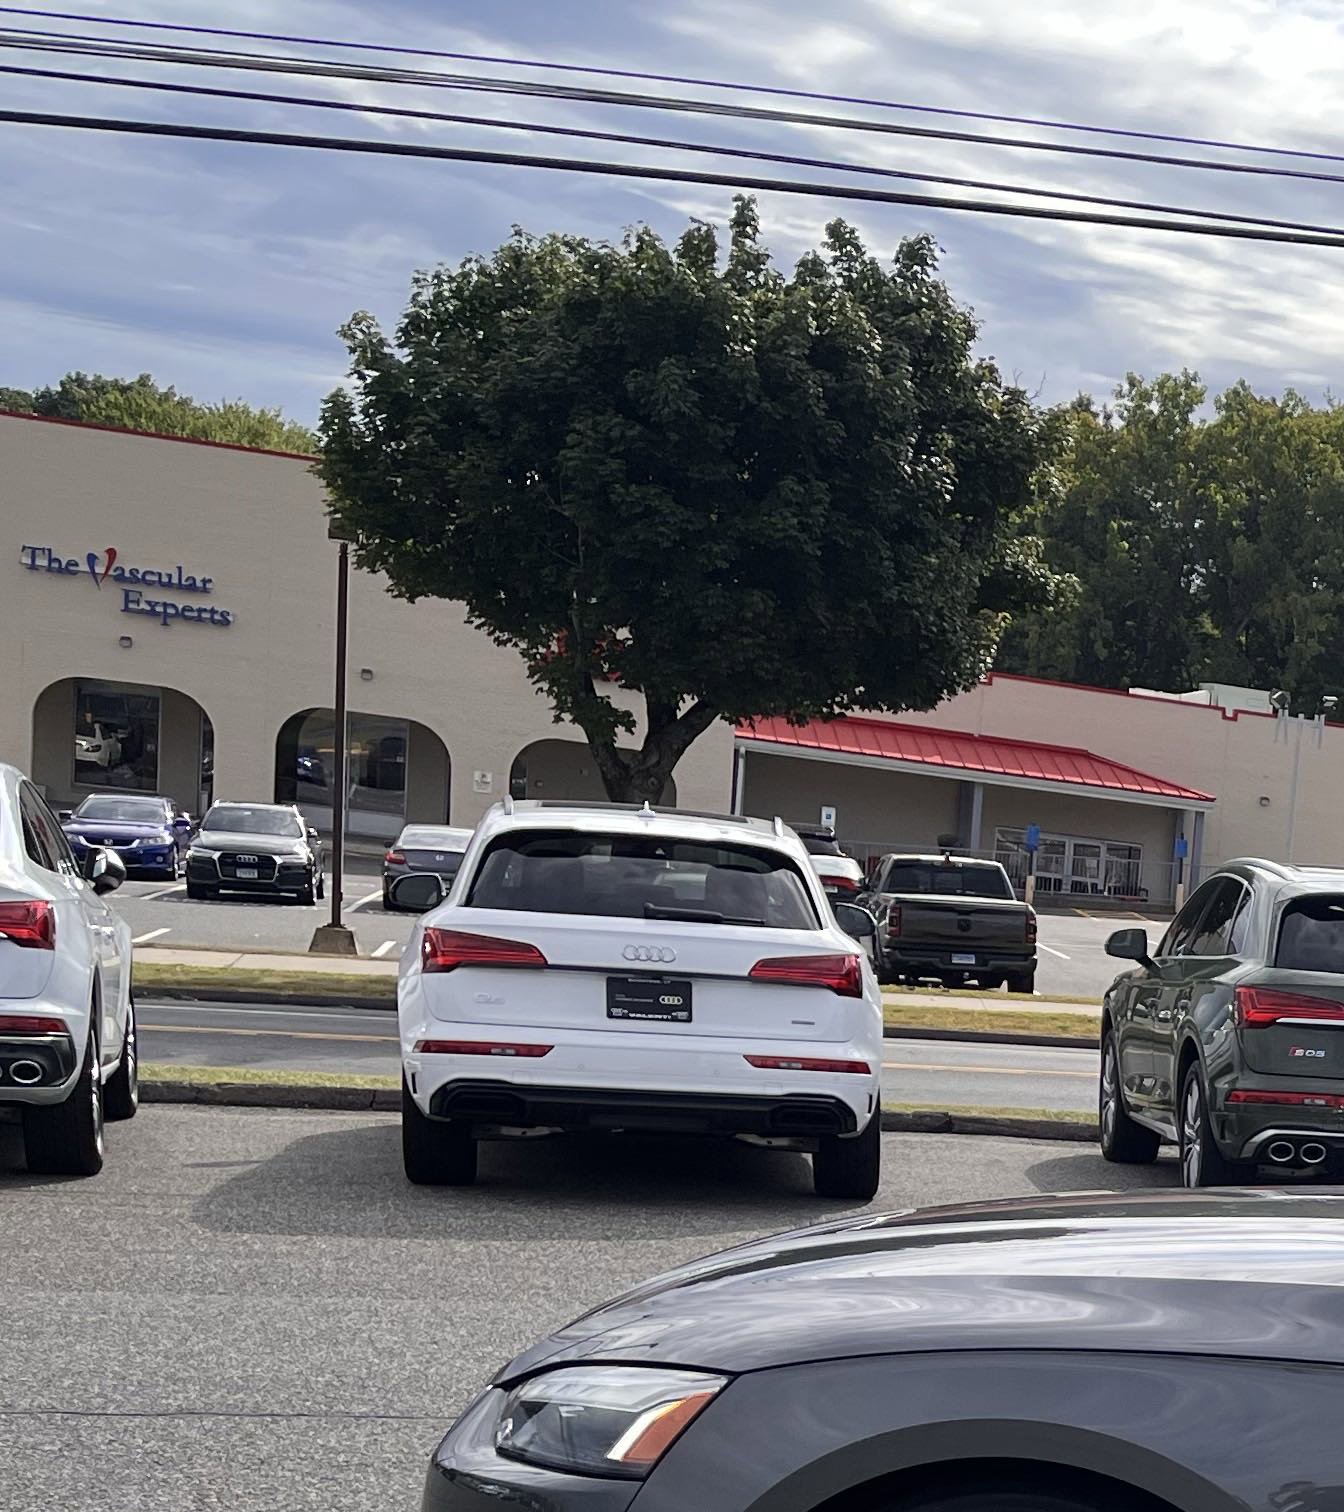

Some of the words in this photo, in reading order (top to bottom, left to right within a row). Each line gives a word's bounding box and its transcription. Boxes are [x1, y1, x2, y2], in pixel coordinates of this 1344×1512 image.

[20, 544, 80, 576] The
[86, 547, 214, 593] Vascular
[120, 588, 235, 627] Experts
